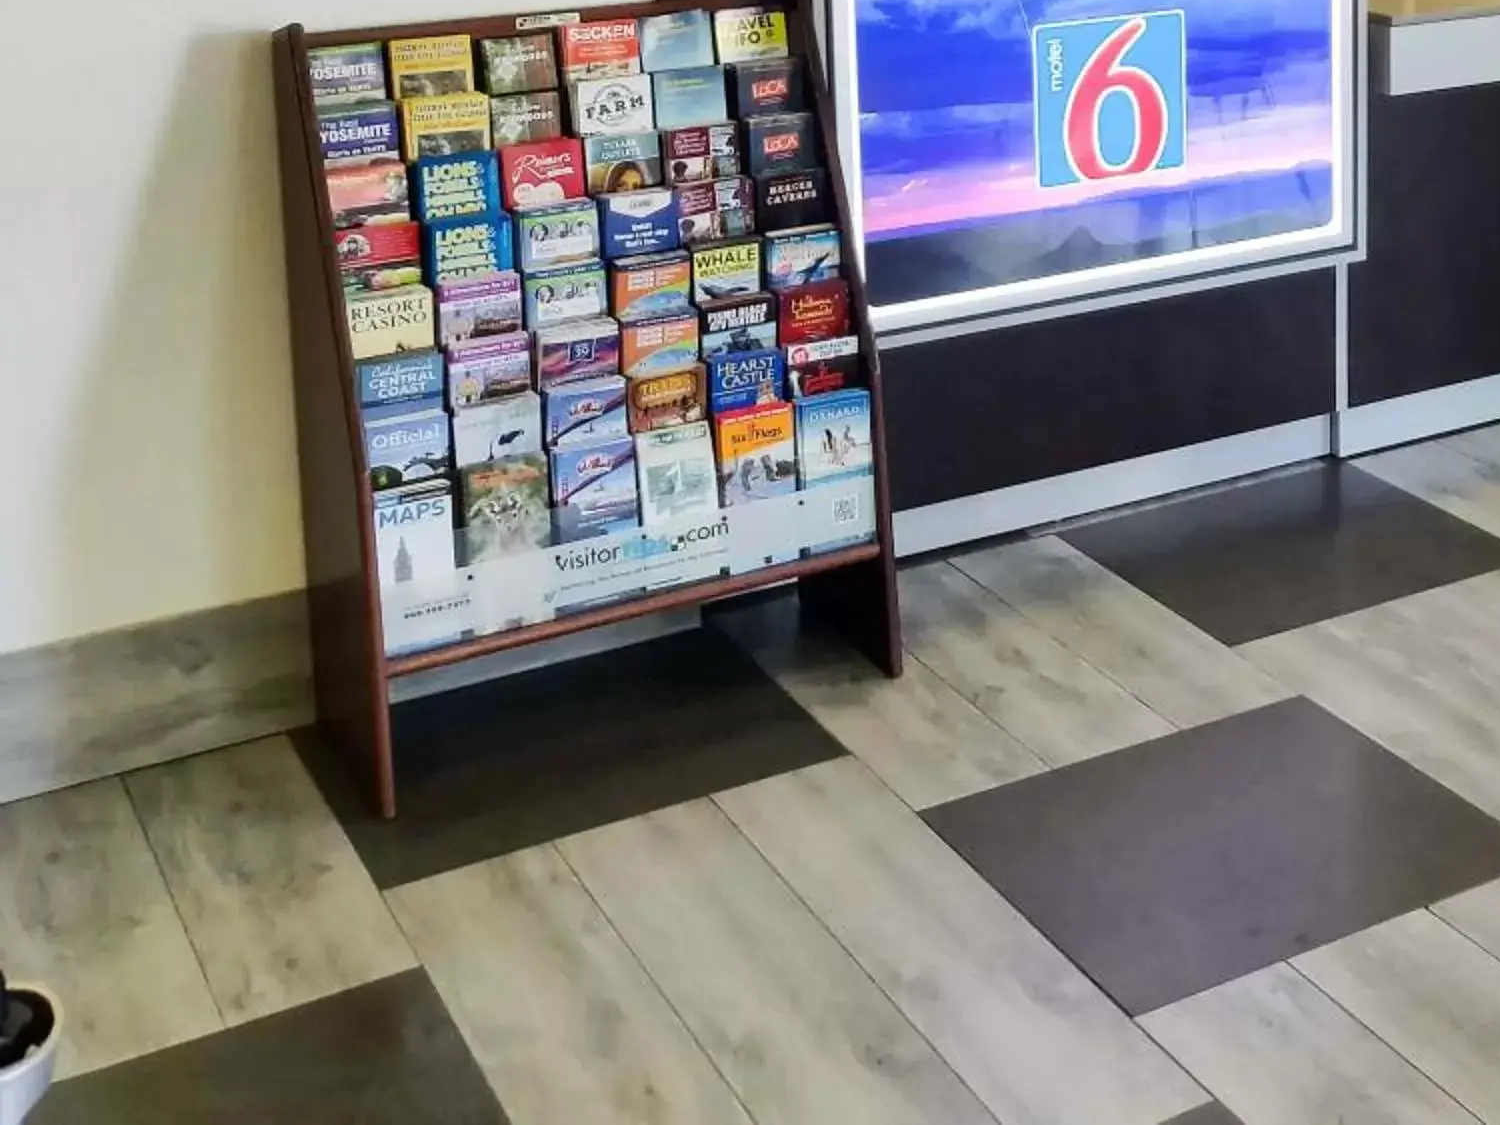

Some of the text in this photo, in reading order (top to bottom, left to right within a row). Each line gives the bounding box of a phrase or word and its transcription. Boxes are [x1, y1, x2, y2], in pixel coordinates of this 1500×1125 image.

[584, 94, 645, 120] FARM
[1046, 16, 1169, 182] motel 6
[320, 123, 392, 145] YOSEMITE
[695, 246, 757, 268] WHALE
[350, 297, 426, 321] RESORT
[351, 312, 428, 334] CASINO
[717, 356, 775, 378] HEARST
[369, 371, 437, 390] CENTRAL
[376, 381, 427, 400] COAST
[721, 369, 776, 390] CASTLE
[371, 424, 441, 449] Official
[379, 499, 446, 529] MAPS
